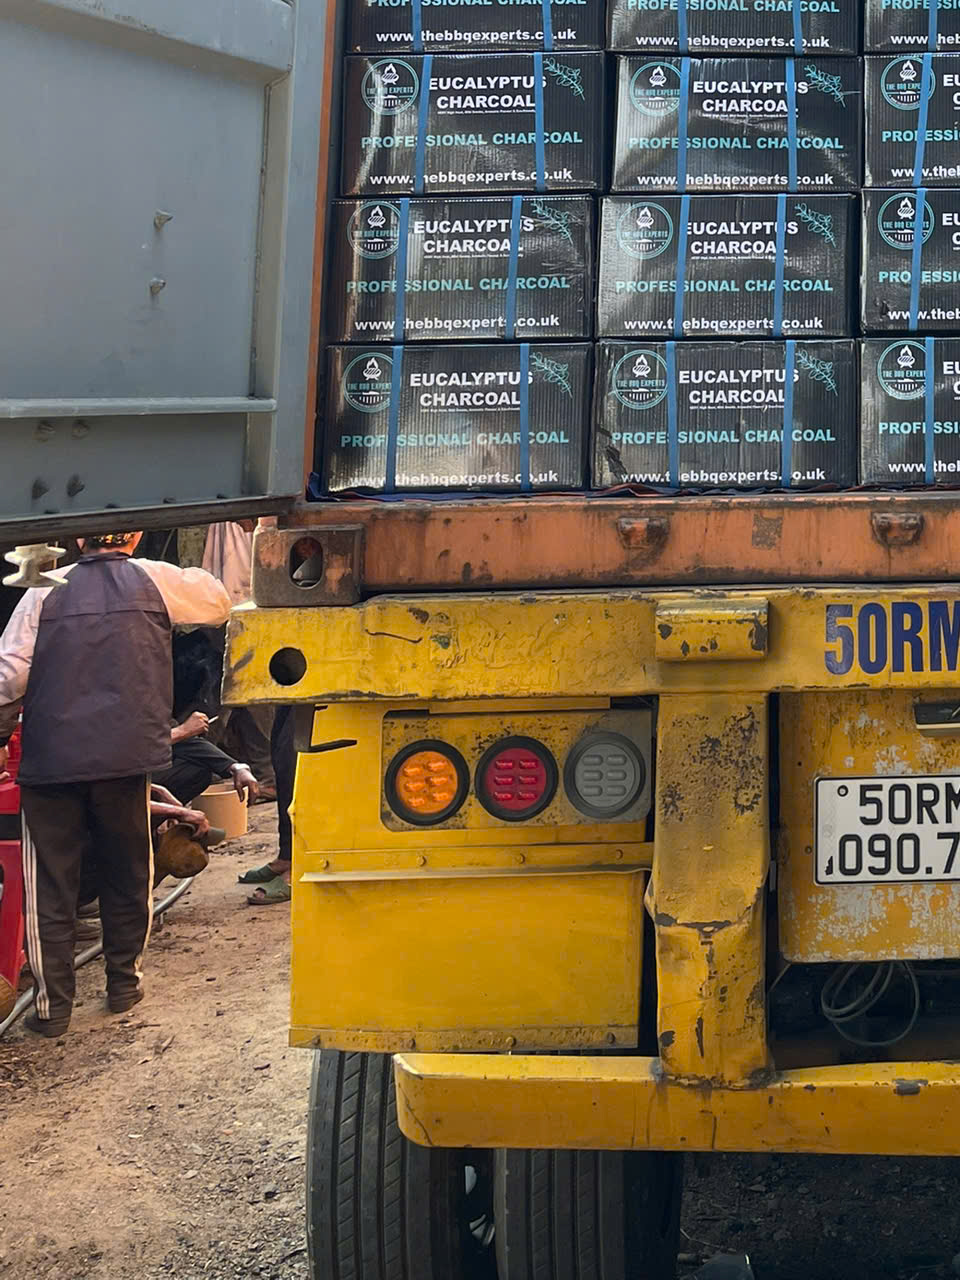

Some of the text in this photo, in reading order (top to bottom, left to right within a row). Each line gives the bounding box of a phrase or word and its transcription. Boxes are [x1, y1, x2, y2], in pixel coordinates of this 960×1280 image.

[692, 80, 809, 94] EUCALYPTS
[436, 94, 536, 109] CHARCOAL
[702, 98, 799, 112] CHARCOA
[360, 133, 487, 148] PROFESIONAL
[423, 237, 524, 253] CHARCOA
[690, 240, 788, 254] CHARCOA
[419, 391, 522, 406] CHARCOAL
[611, 428, 836, 445] PROFESIONAL CHACOAL
